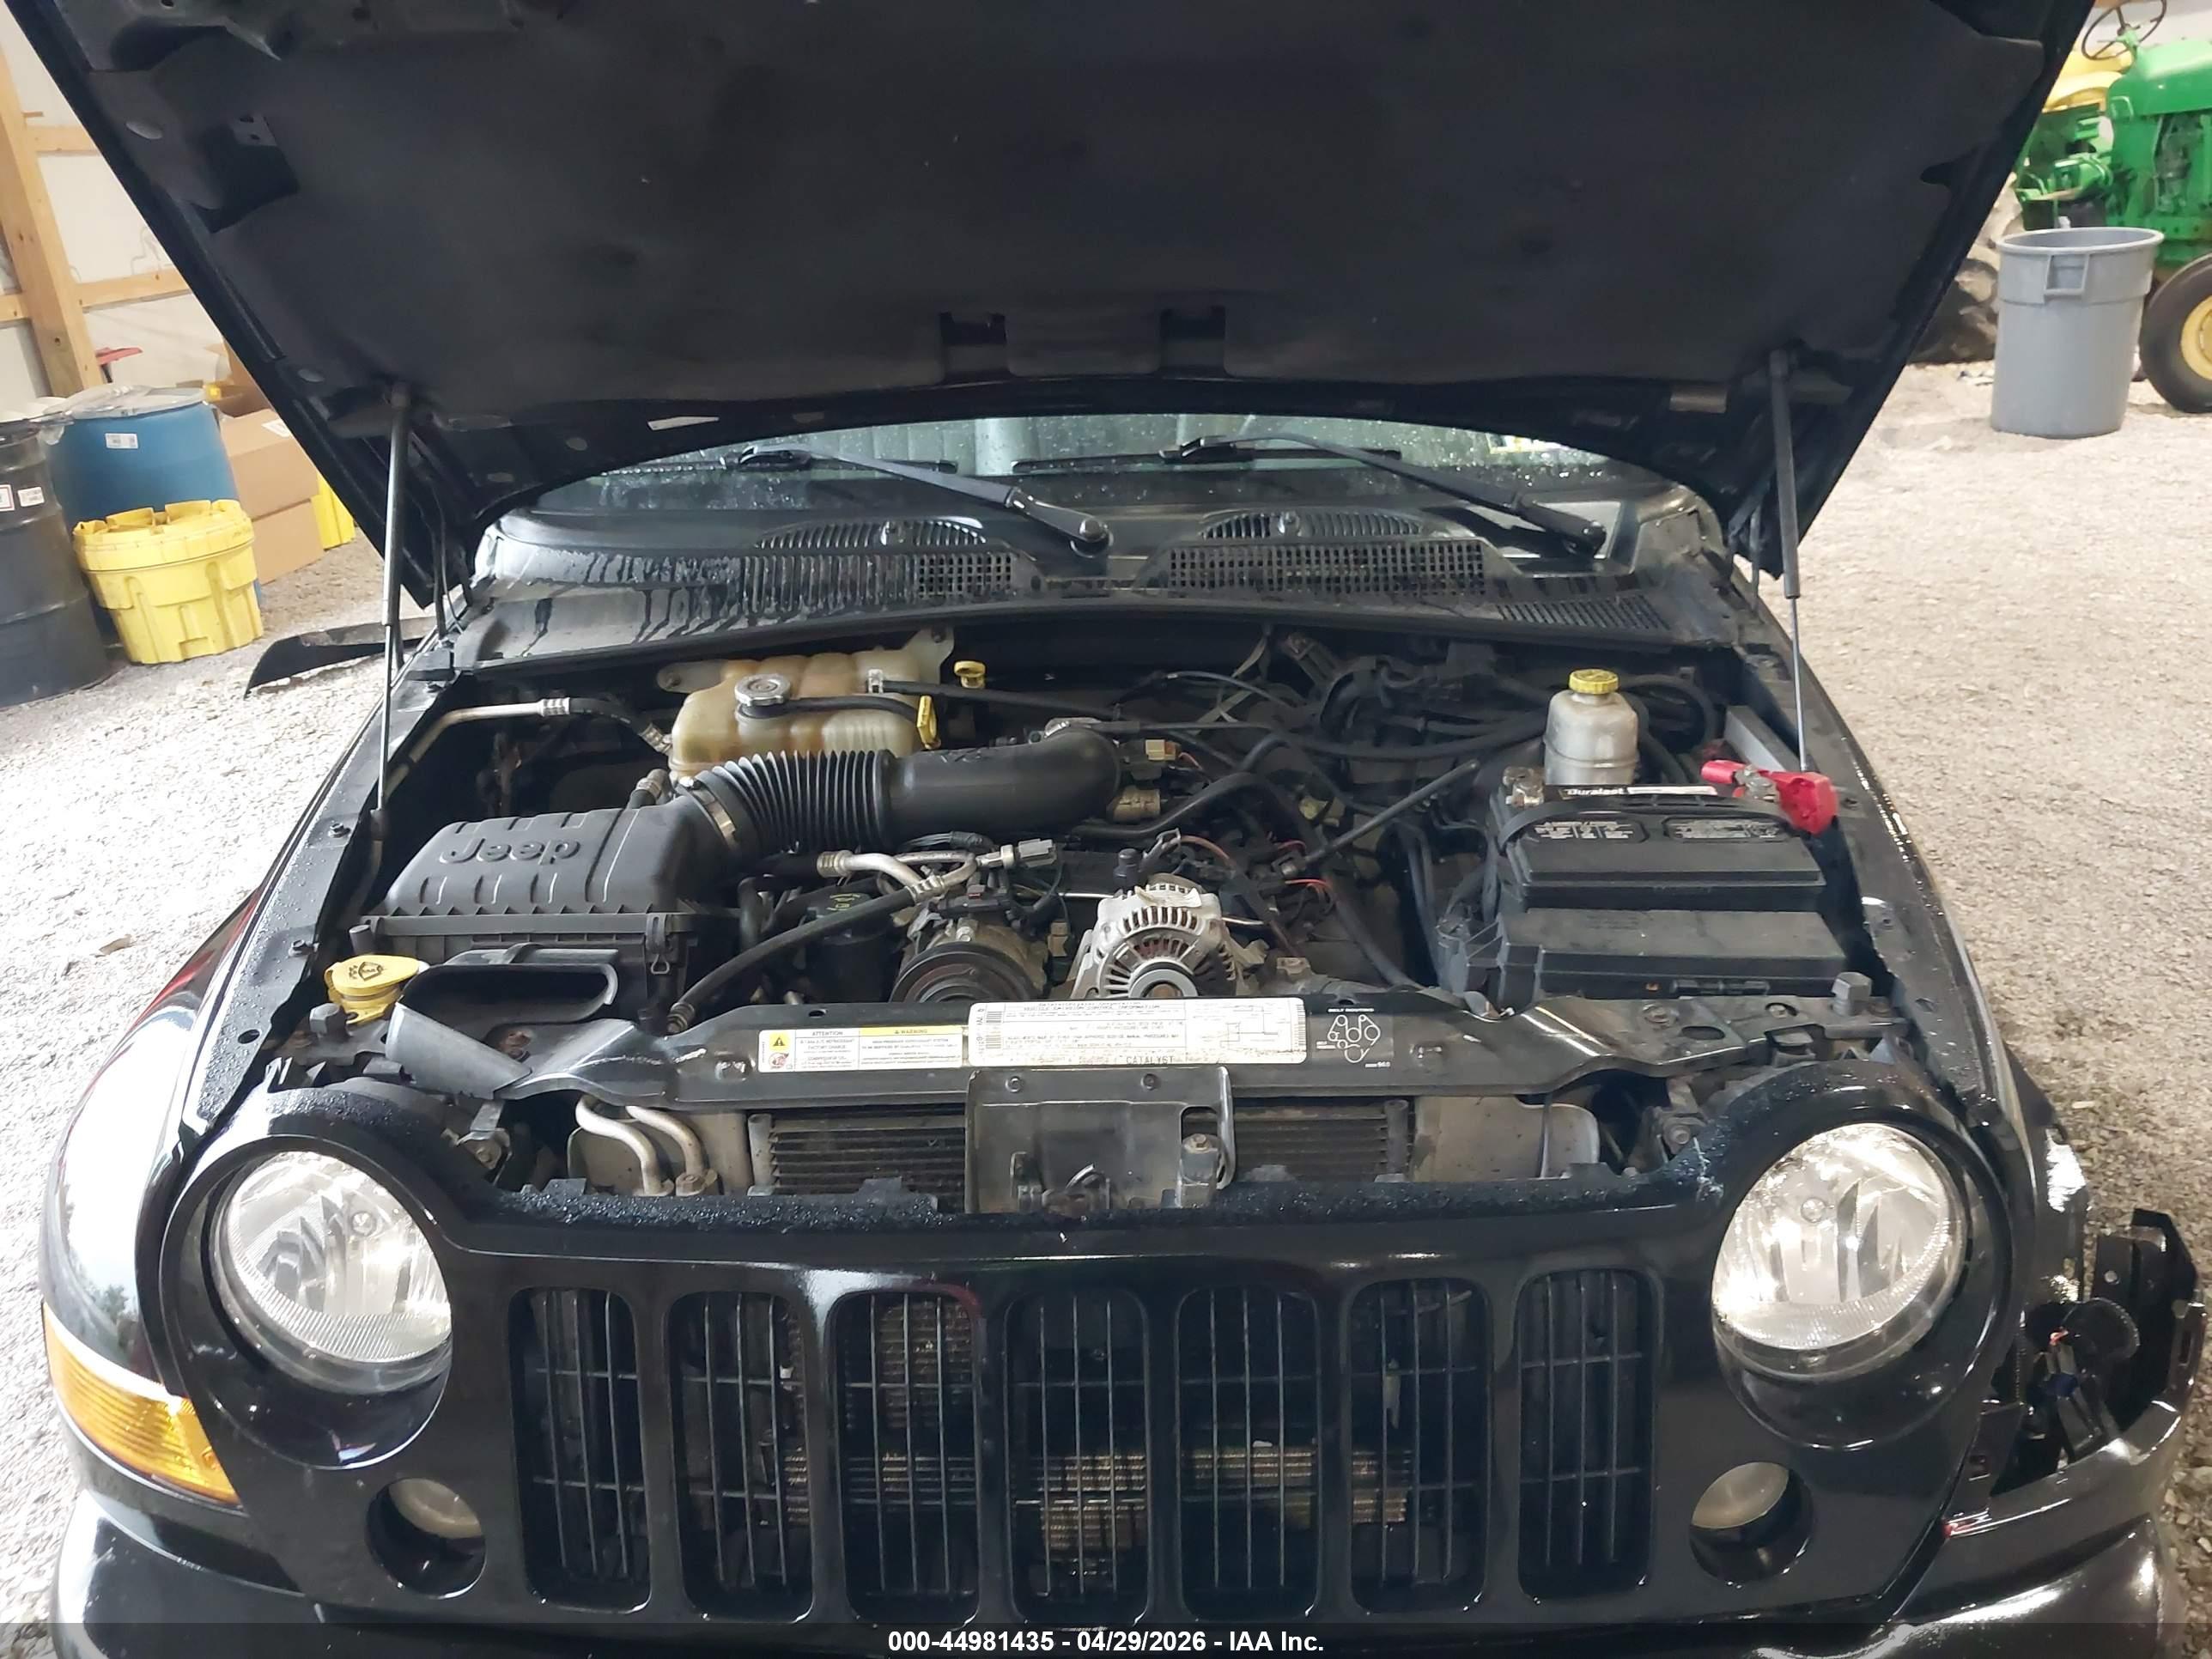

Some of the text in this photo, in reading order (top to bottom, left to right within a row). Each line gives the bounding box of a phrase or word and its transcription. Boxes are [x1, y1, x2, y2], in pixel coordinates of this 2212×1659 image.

[1564, 787, 1624, 796] Duralast
[439, 837, 580, 866] Jeep
[1126, 1055, 1175, 1065] CATALYST
